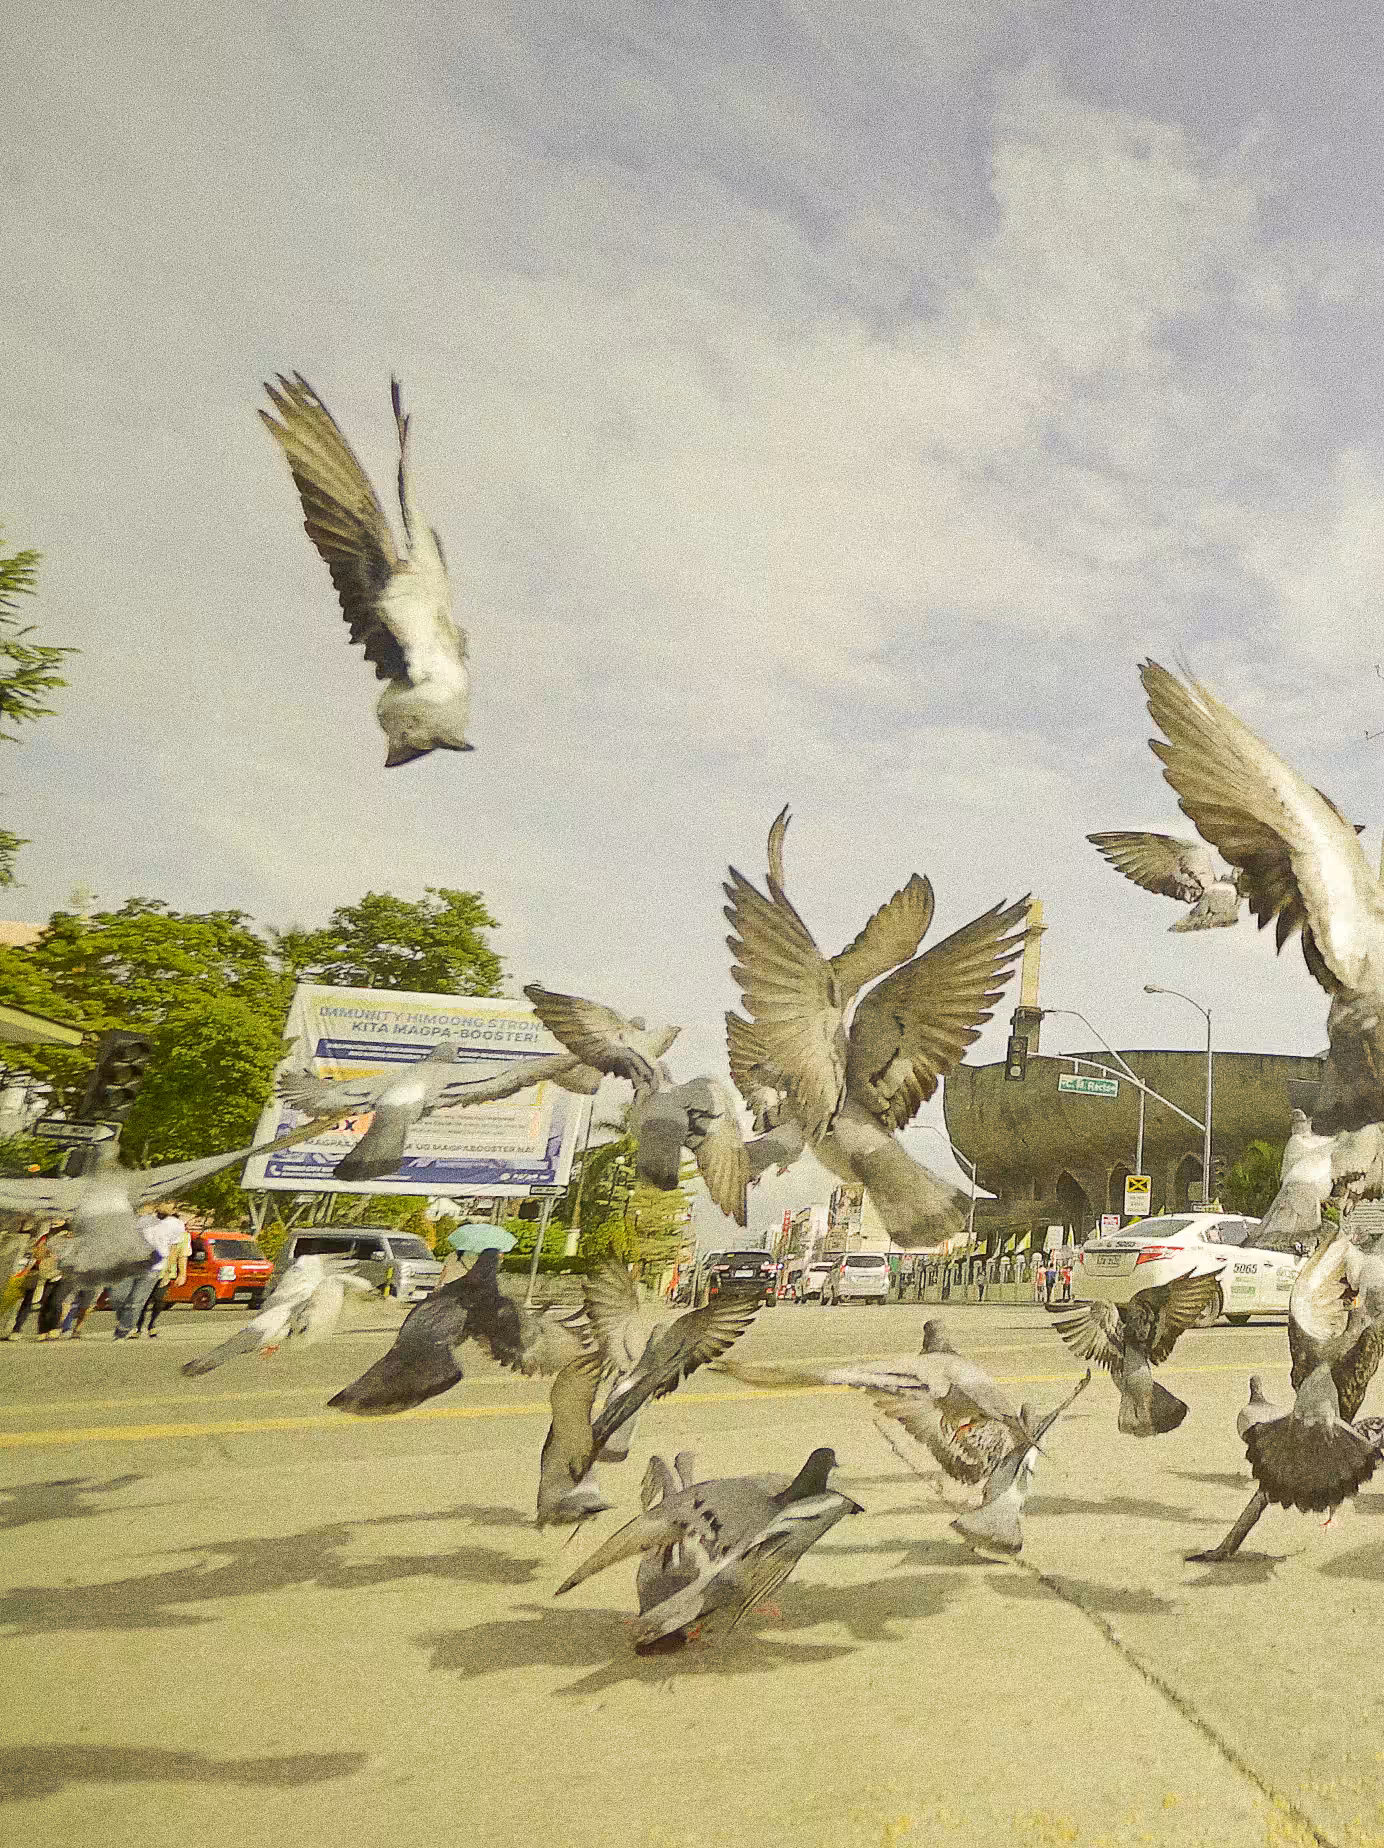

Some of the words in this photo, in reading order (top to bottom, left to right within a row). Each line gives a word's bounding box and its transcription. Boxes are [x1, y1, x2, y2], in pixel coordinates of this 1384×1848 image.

[320, 1007, 403, 1023] IMMUNITY
[351, 1021, 389, 1033] KITA
[1233, 1263, 1258, 1274] 5065
